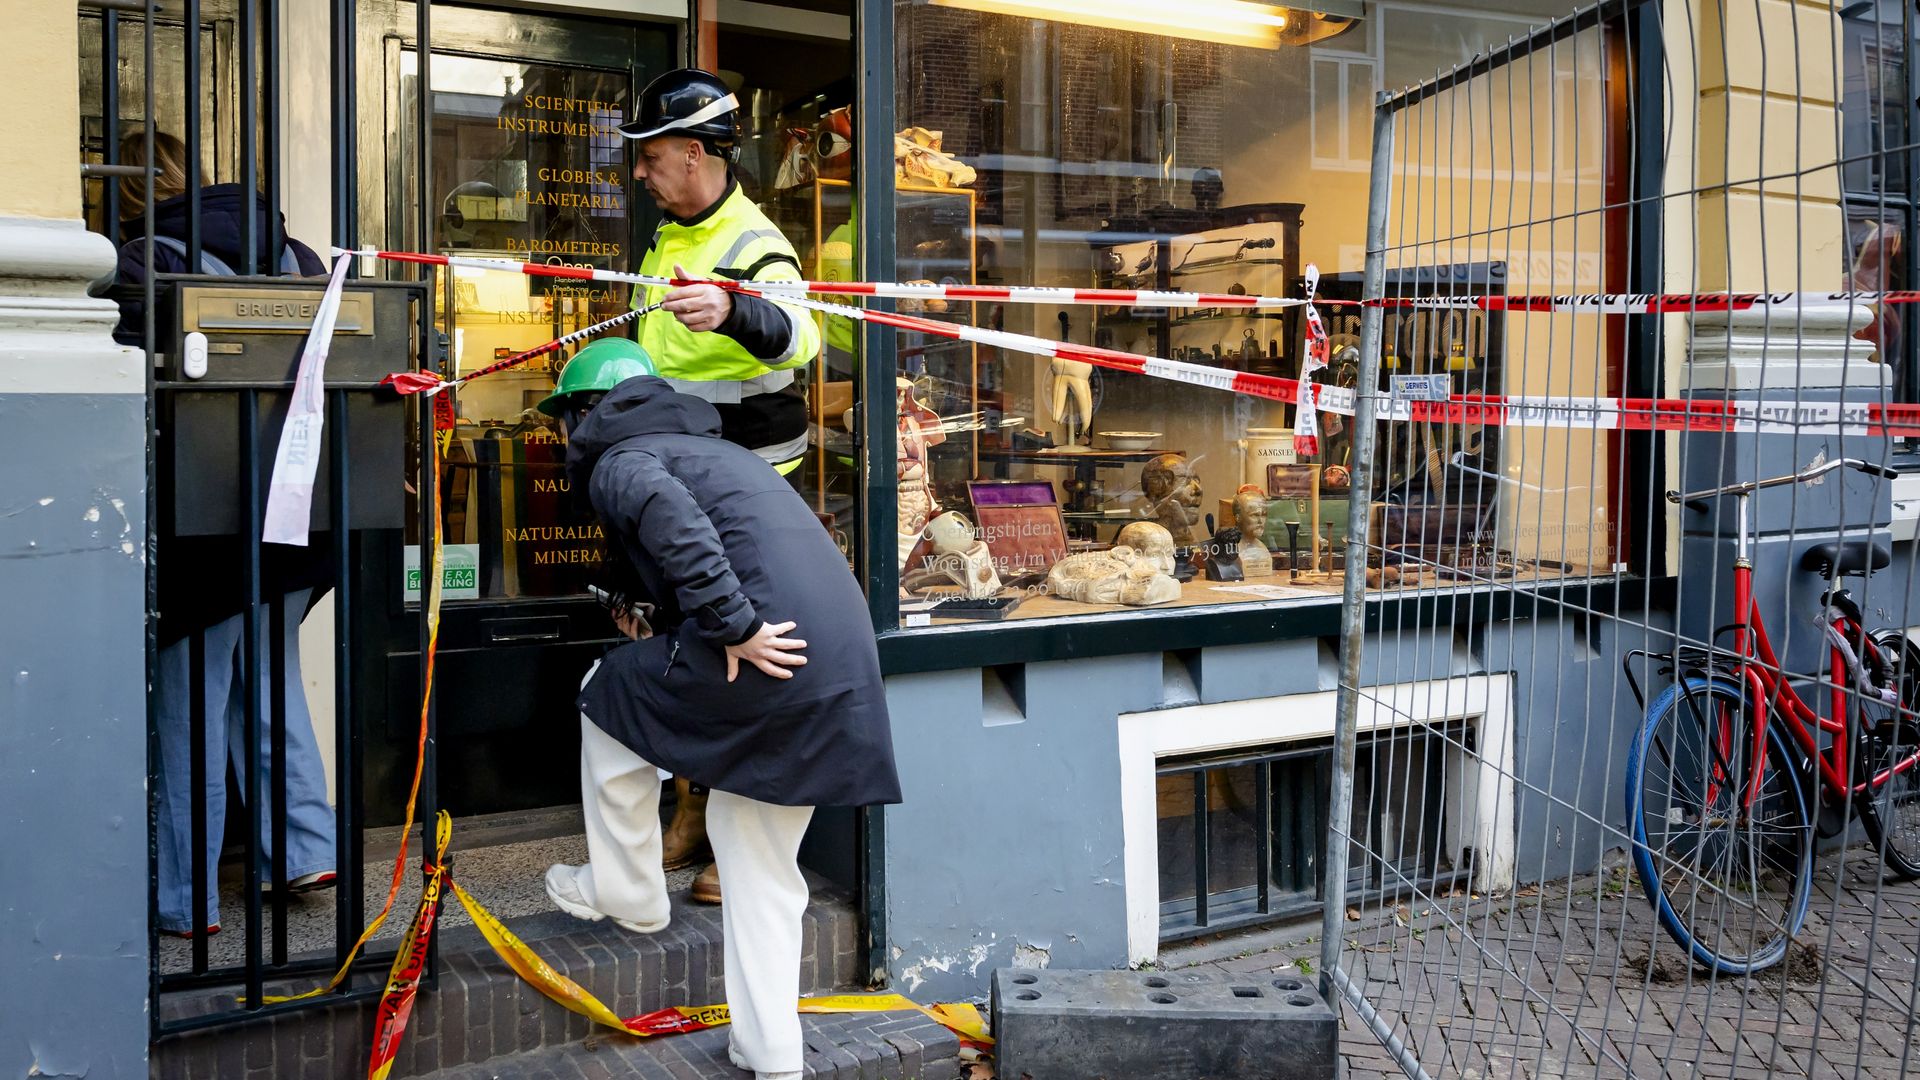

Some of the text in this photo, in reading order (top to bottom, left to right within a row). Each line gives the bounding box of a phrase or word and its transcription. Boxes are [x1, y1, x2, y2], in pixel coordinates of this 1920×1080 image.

[524, 95, 620, 114] SCIENTIFIC
[538, 167, 620, 185] GLOBES &
[515, 190, 619, 209] PLANETARIA
[506, 237, 620, 256] BAROMETRES
[543, 288, 620, 304] MEDICAL
[1257, 448, 1294, 458] SANGSUES
[533, 479, 571, 493] NAU
[505, 525, 605, 542] NATURALIA
[921, 519, 1058, 544] Oeningstijden:
[533, 549, 604, 565] MINERA
[1014, 550, 1046, 569] t/m
[1183, 543, 1220, 563] 17.30
[409, 570, 473, 580] CERA
